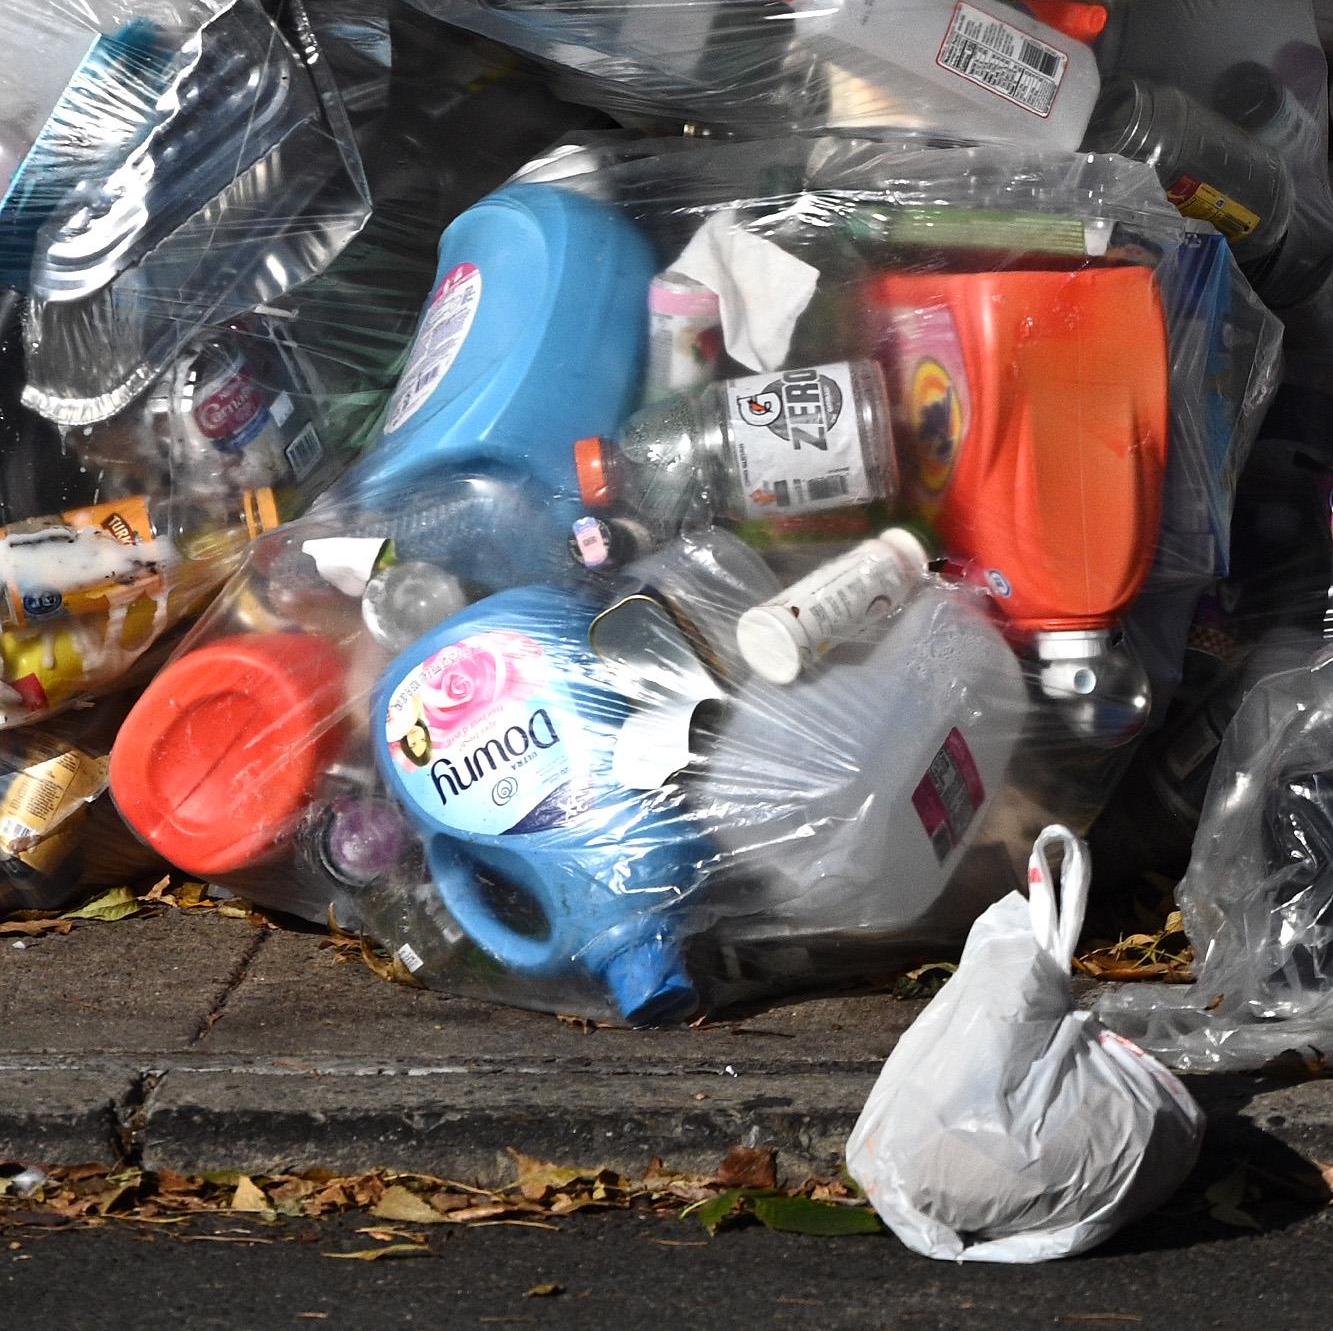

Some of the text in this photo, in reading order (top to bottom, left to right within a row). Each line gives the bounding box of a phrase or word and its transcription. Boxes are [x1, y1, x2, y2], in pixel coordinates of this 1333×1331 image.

[737, 390, 783, 427] G
[782, 368, 829, 451] ZERO
[430, 708, 561, 806] Downy
[510, 751, 538, 771] ULTRA
